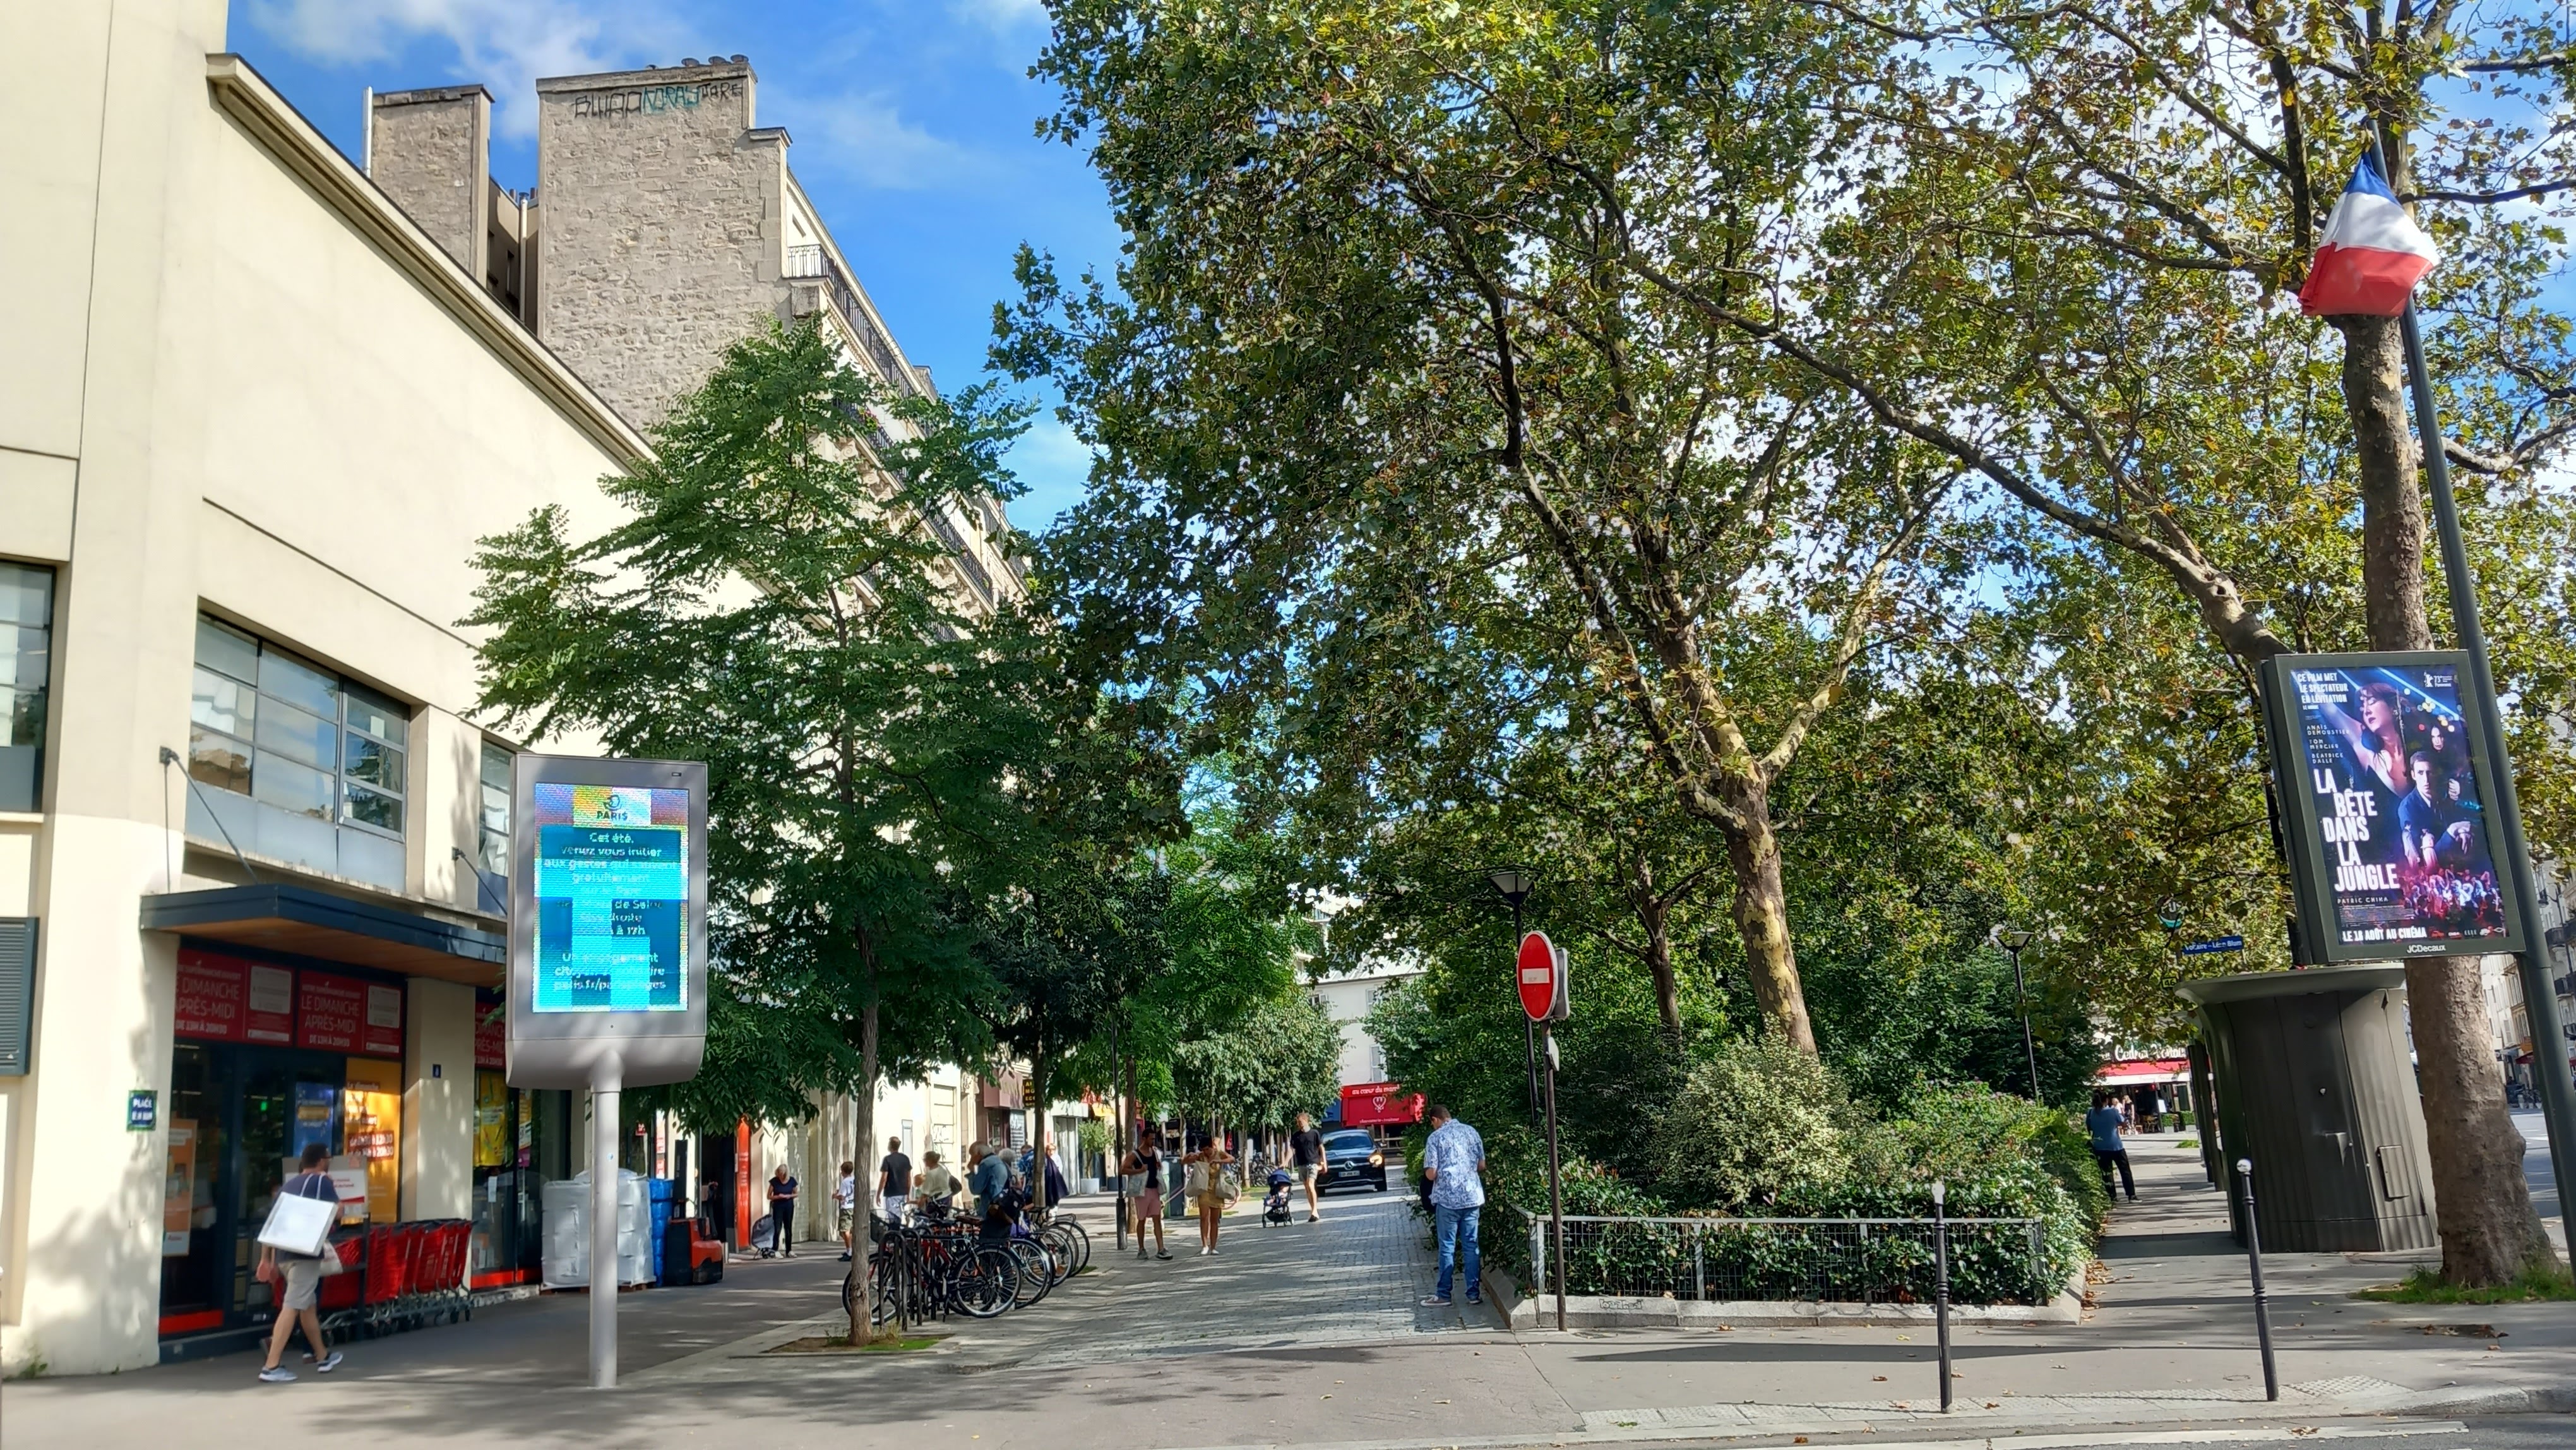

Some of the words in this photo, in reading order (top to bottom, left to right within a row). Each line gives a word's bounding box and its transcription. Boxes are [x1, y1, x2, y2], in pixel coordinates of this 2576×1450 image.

[2298, 673, 2306, 682] CE
[2307, 673, 2323, 682] FILM
[2324, 673, 2337, 681] MET
[2300, 684, 2308, 693] LE
[2309, 683, 2349, 692] SPECTATEUR
[2301, 695, 2311, 703] EN
[2311, 693, 2347, 703] LÉVITATION
[2313, 768, 2337, 794] LA
[2334, 788, 2378, 817] BÊTE
[597, 811, 628, 821] PARIS
[2322, 816, 2370, 842] DANS
[598, 848, 625, 856] vous
[2337, 841, 2361, 866] LA
[2334, 863, 2400, 892] JUNGLE
[615, 900, 630, 909] de
[2342, 931, 2353, 942] LE
[2365, 928, 2384, 940] AOÛT
[2386, 928, 2397, 940] AU
[2398, 926, 2427, 938] CINÉMA
[2407, 944, 2447, 954] JCDecaux
[181, 976, 240, 1000] DIMANCHE
[301, 995, 313, 1010] LE
[314, 996, 359, 1017] DIMANCHE
[304, 1013, 356, 1033] APRÈS-MIDI
